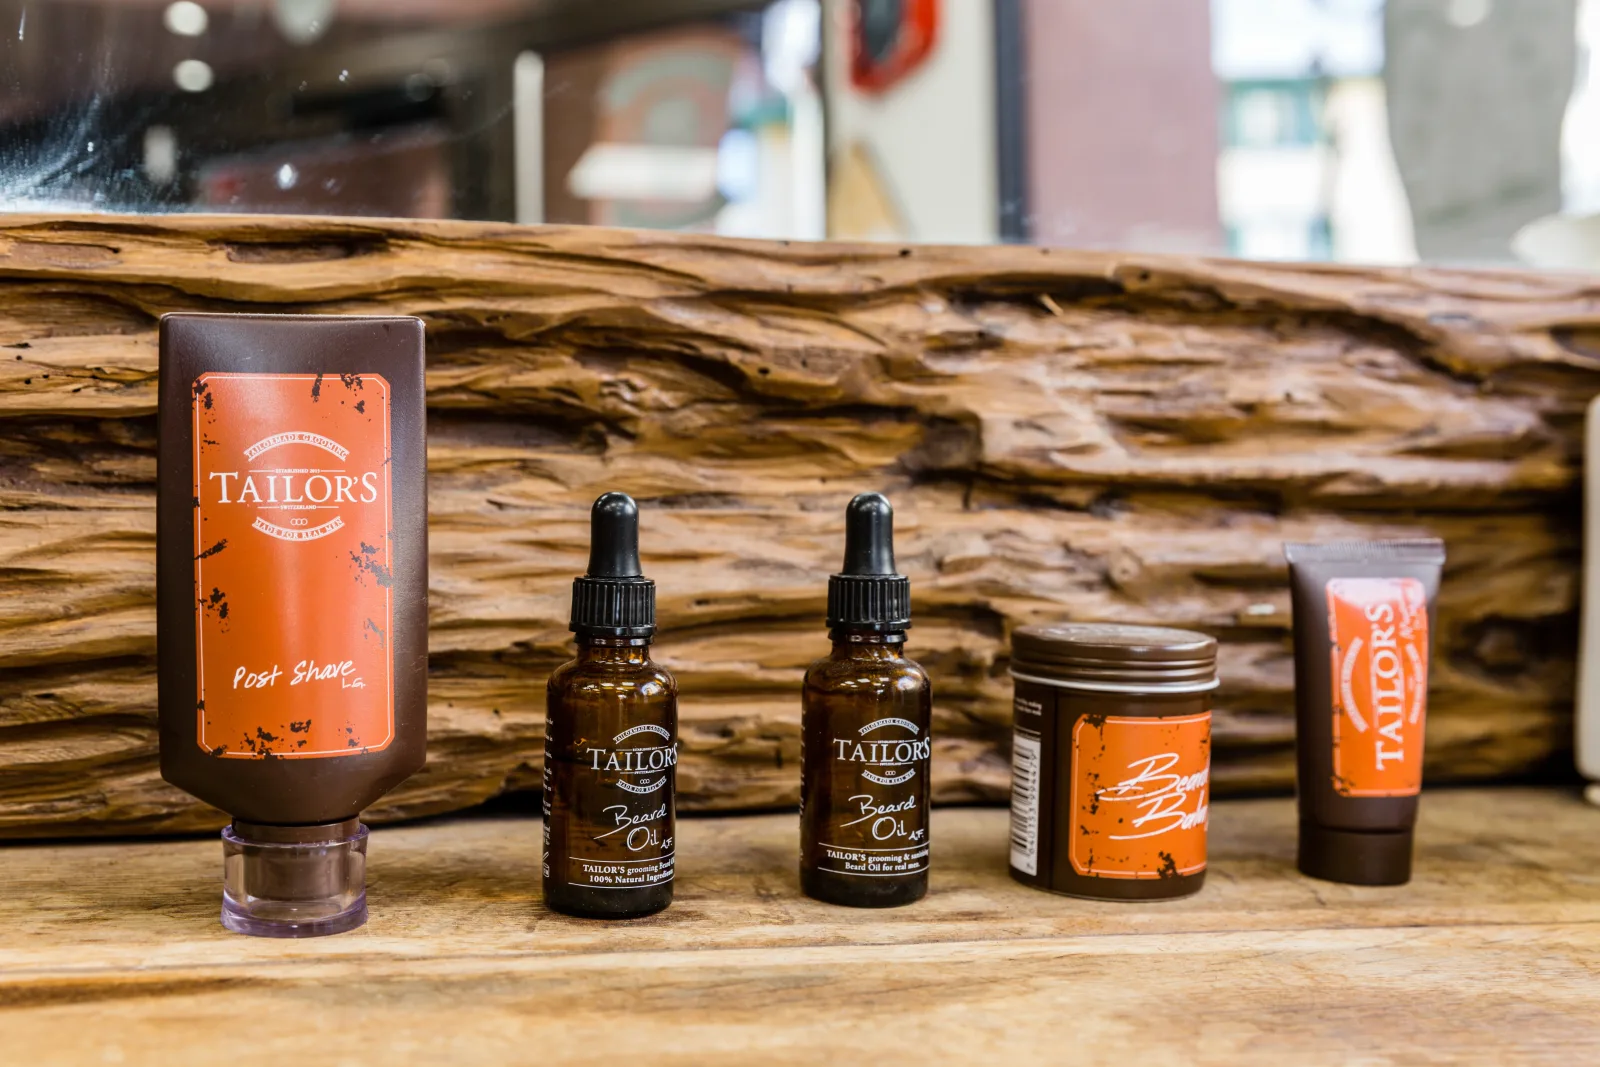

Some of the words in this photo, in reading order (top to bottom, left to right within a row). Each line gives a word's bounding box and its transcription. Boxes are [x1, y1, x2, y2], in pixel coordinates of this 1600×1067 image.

[246, 433, 300, 459] TAILORMADE
[302, 433, 348, 459] GROOMING
[209, 471, 378, 504] TAILOR'S
[255, 518, 278, 536] MADE
[280, 529, 299, 540] FOR
[302, 528, 324, 540] REAL
[324, 517, 343, 533] MEN
[233, 665, 283, 690] Post
[289, 659, 357, 686] Shave
[1363, 603, 1405, 771] TAILOR'S
[585, 741, 678, 771] TAILOR'S
[832, 736, 931, 763] TAILOR'S
[592, 803, 668, 840] Beard
[840, 794, 917, 828] Beard
[626, 826, 660, 851] Oil
[871, 816, 908, 841] Oil
[826, 849, 867, 861] TAILOR'S
[867, 854, 903, 864] grooming
[845, 862, 867, 871] Beard
[868, 863, 881, 871] Oil
[882, 863, 893, 871] for
[894, 863, 907, 871] real
[582, 864, 626, 875] TAILOR'S
[627, 864, 659, 876] grooming
[589, 875, 613, 884] 100%
[614, 874, 645, 884] Natural
